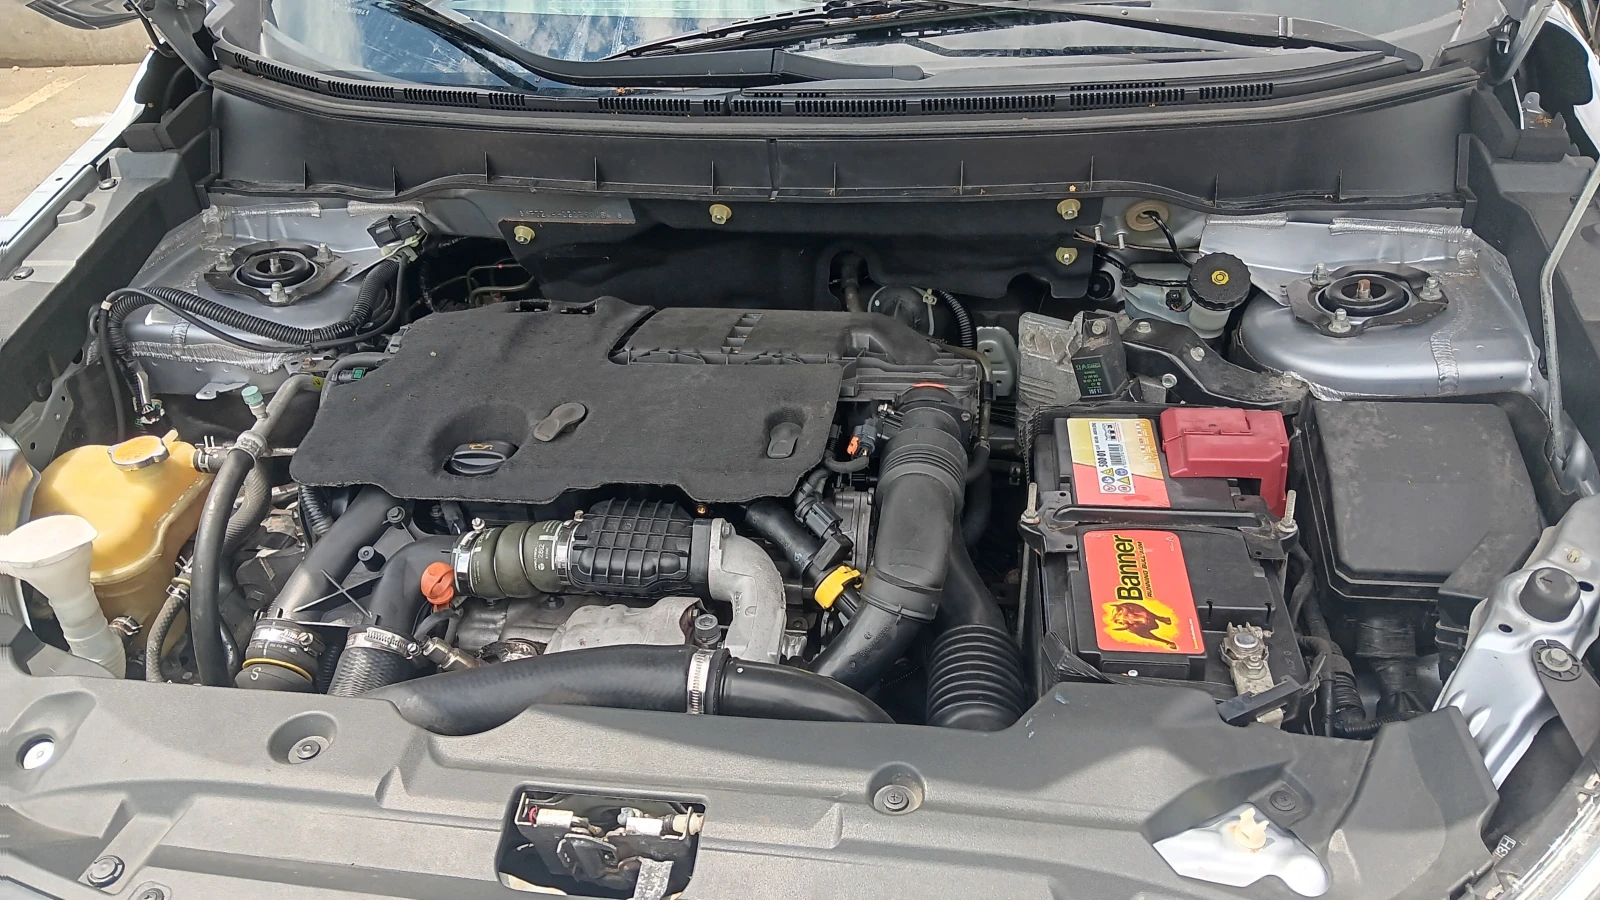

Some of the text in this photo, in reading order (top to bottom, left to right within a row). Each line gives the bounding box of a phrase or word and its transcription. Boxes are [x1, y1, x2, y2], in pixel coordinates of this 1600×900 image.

[1114, 535, 1143, 600] Banner
[1136, 541, 1153, 597] RUNNING BULL AGM
[250, 667, 261, 680] S
